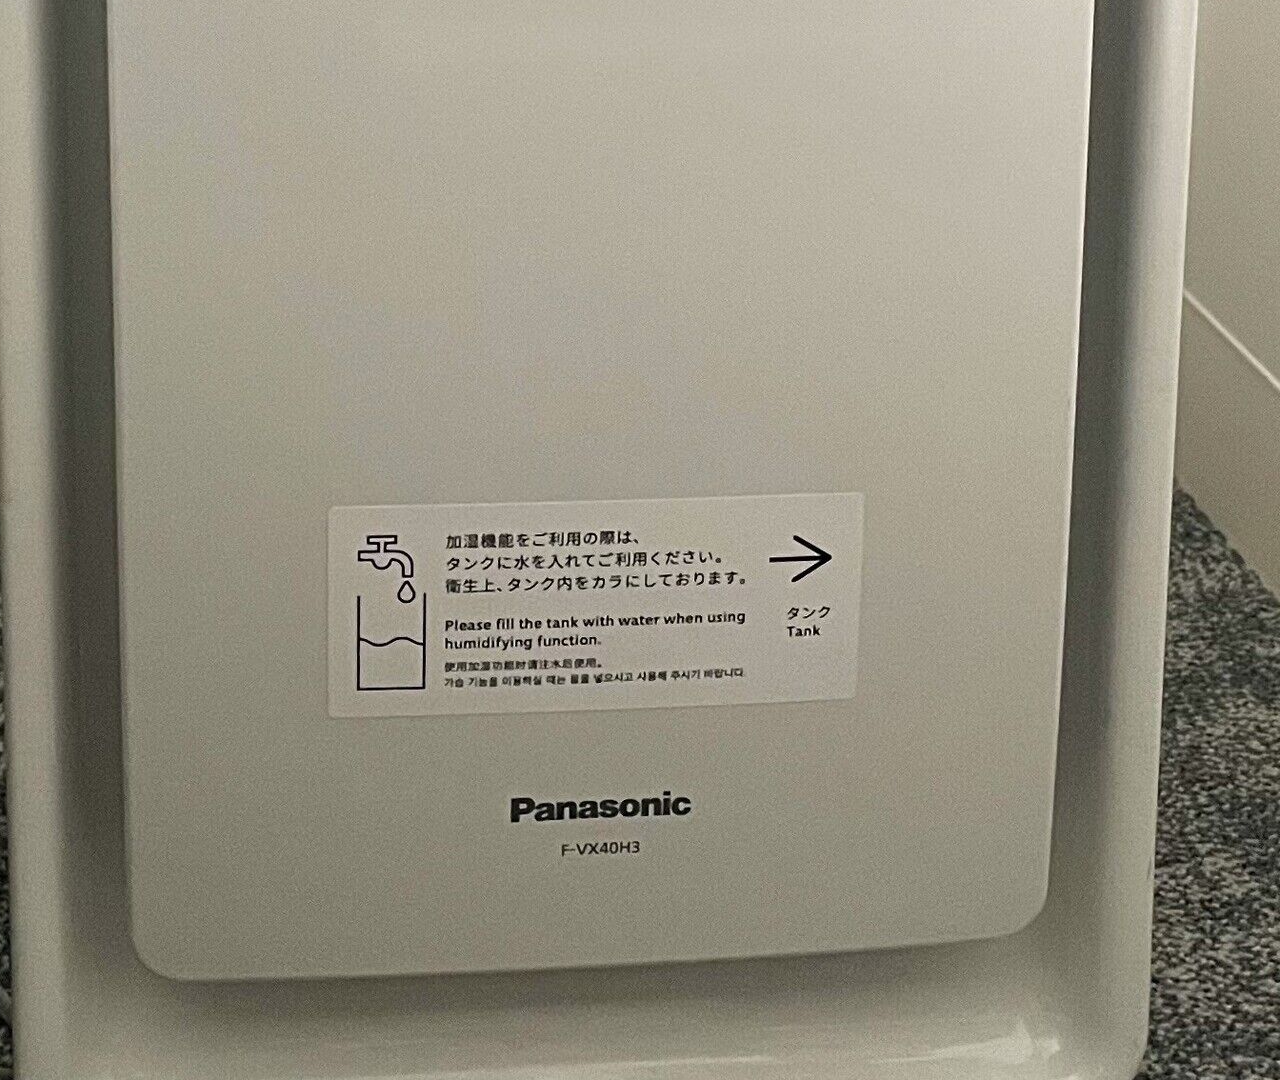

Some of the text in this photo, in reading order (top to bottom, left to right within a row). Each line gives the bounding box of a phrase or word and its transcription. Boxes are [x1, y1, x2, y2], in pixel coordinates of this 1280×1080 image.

[446, 551, 722, 571] タンクに水を入れてご利用ください。
[787, 606, 831, 620] タンク
[445, 611, 746, 632] Please fill the tank with water when using
[786, 624, 821, 637] Tank
[444, 634, 602, 651] humidifying function.
[670, 669, 701, 681] 주시기
[510, 791, 691, 823] Panasonic
[561, 841, 640, 857] F-VX40H3
